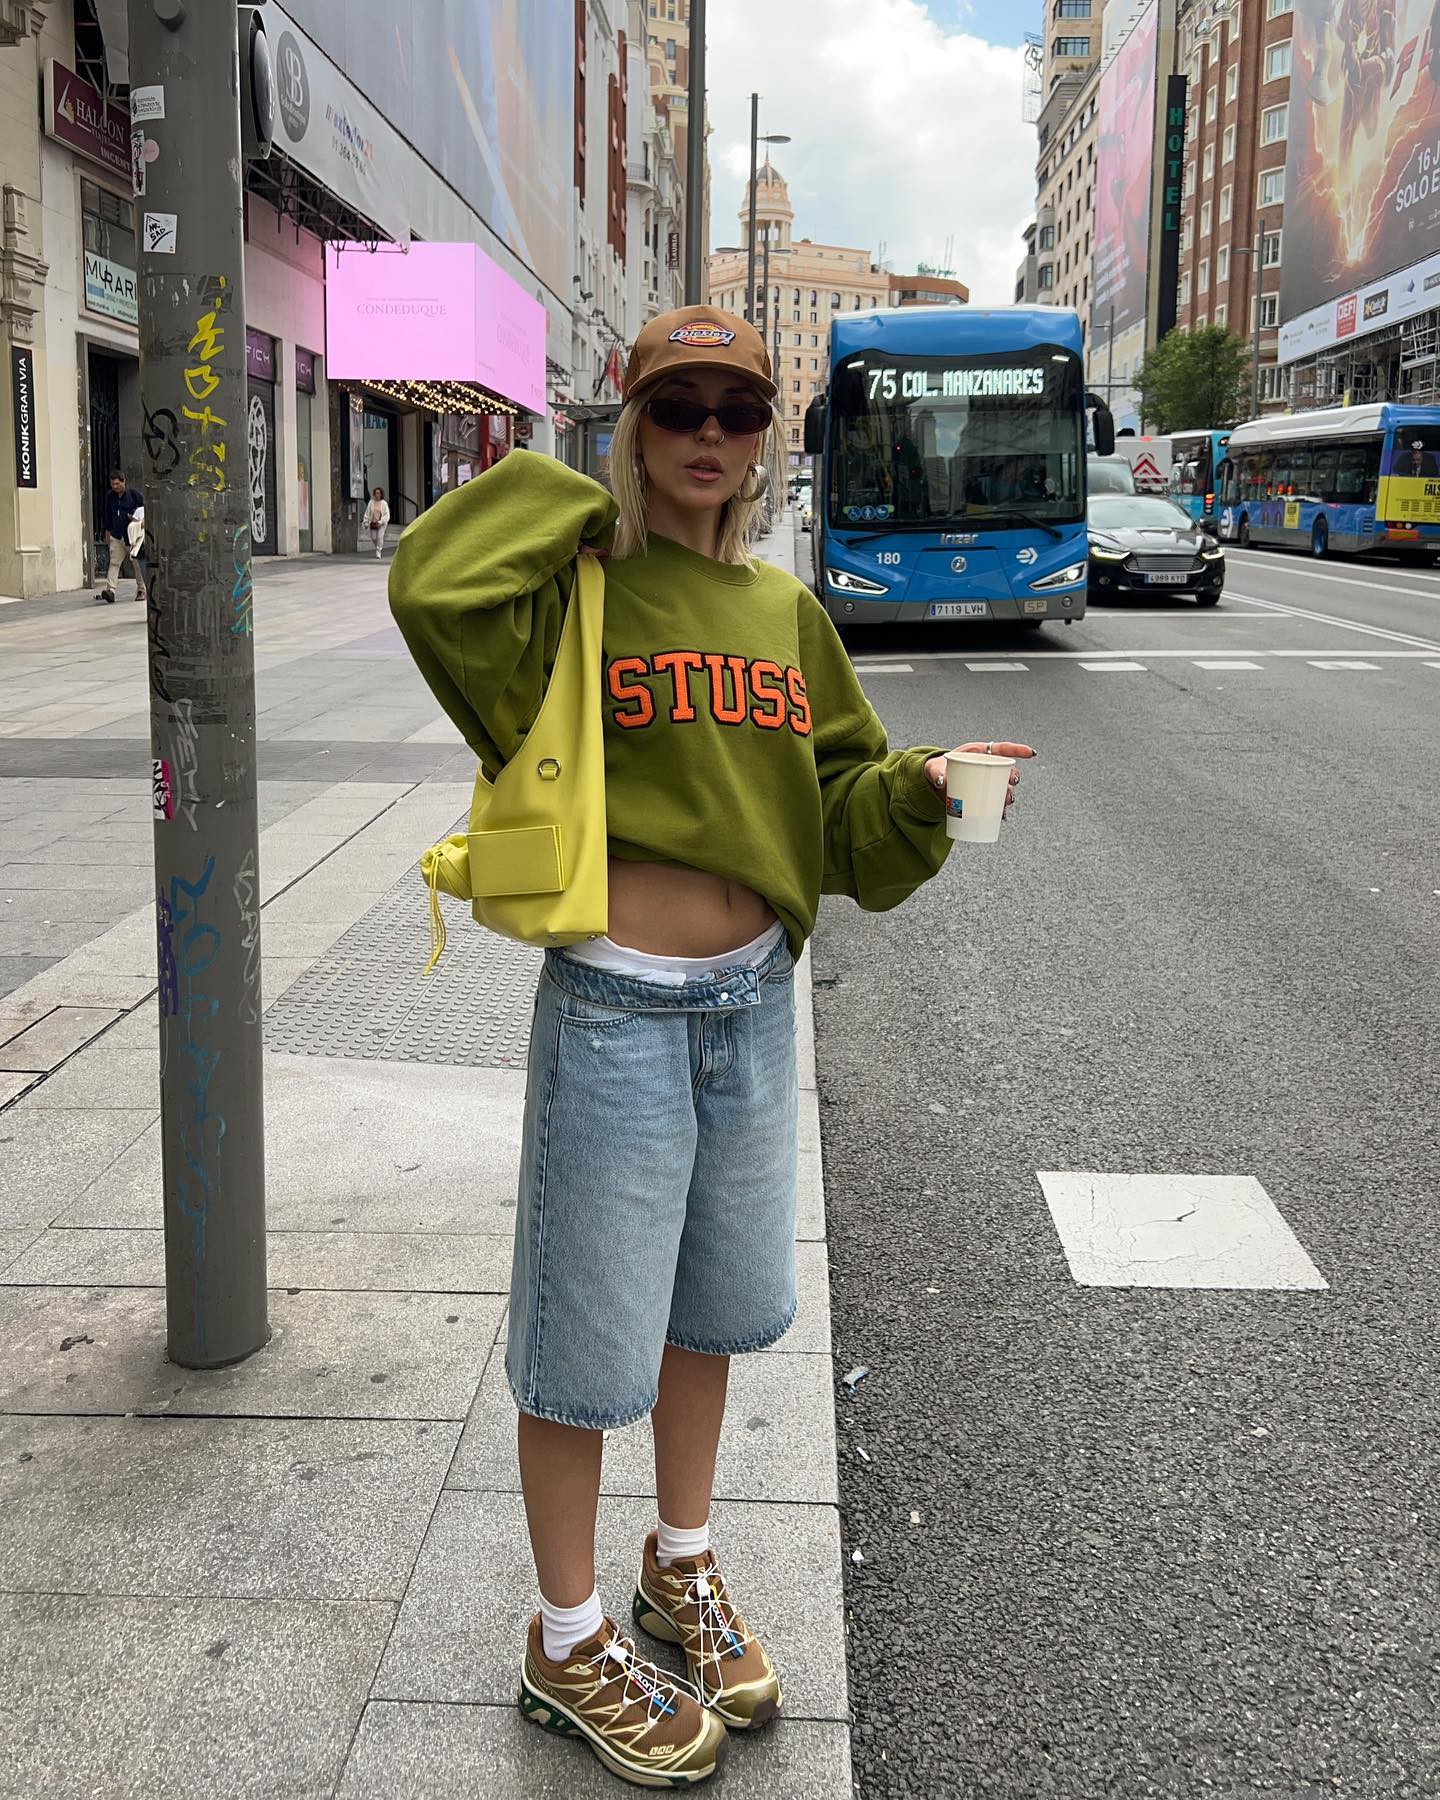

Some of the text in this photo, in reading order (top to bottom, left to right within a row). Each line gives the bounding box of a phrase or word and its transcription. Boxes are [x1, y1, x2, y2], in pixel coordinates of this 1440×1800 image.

[1163, 107, 1184, 231] HOTEL
[1418, 147, 1431, 174] 16
[1395, 175, 1429, 212] SOLO
[85, 256, 137, 301] MURARI
[356, 303, 447, 318] CONDEDUQUE
[18, 357, 27, 381] VIA
[868, 368, 1045, 400] 75 COL. MANZANARES
[876, 552, 901, 565] 180
[937, 603, 985, 616] 7119 LVH
[1026, 602, 1046, 613] SP
